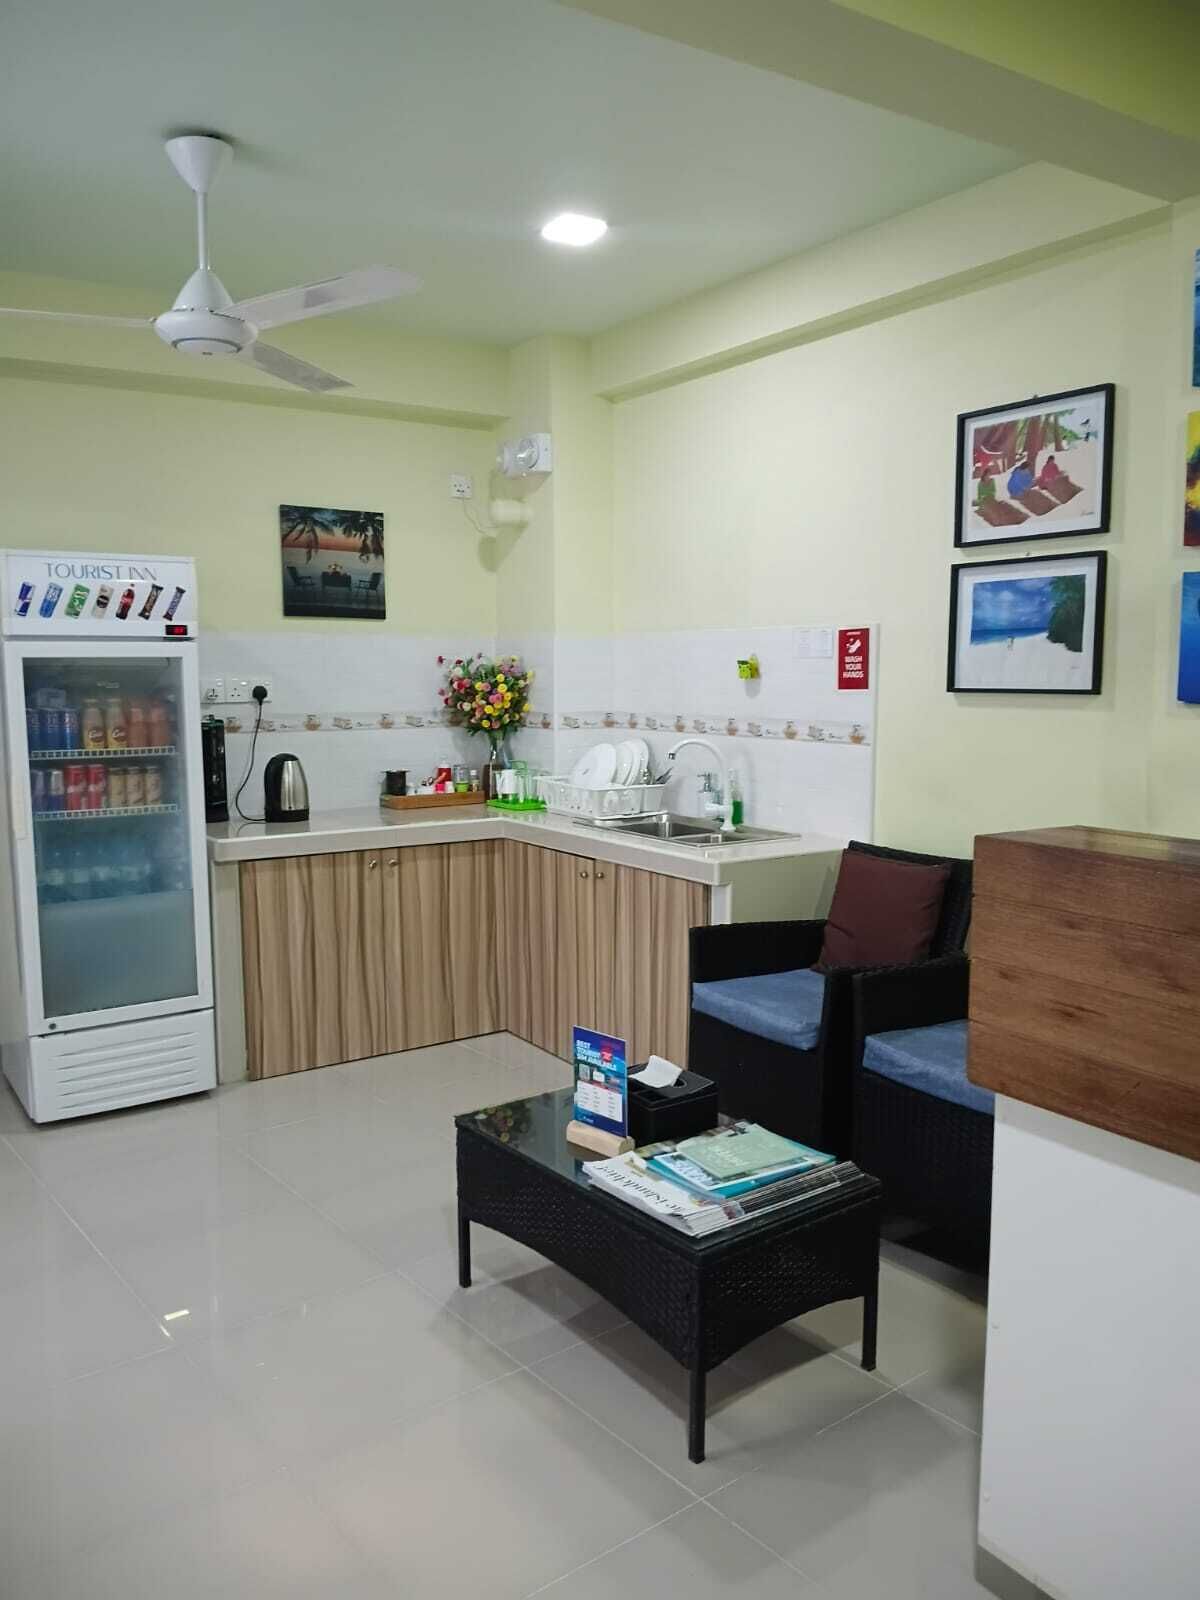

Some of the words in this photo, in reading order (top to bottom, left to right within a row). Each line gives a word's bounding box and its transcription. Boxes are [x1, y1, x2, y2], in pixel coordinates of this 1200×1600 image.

[43, 562, 123, 580] TOURIST
[127, 566, 158, 581] INN
[844, 655, 863, 663] WASH
[842, 670, 864, 679] HANDS
